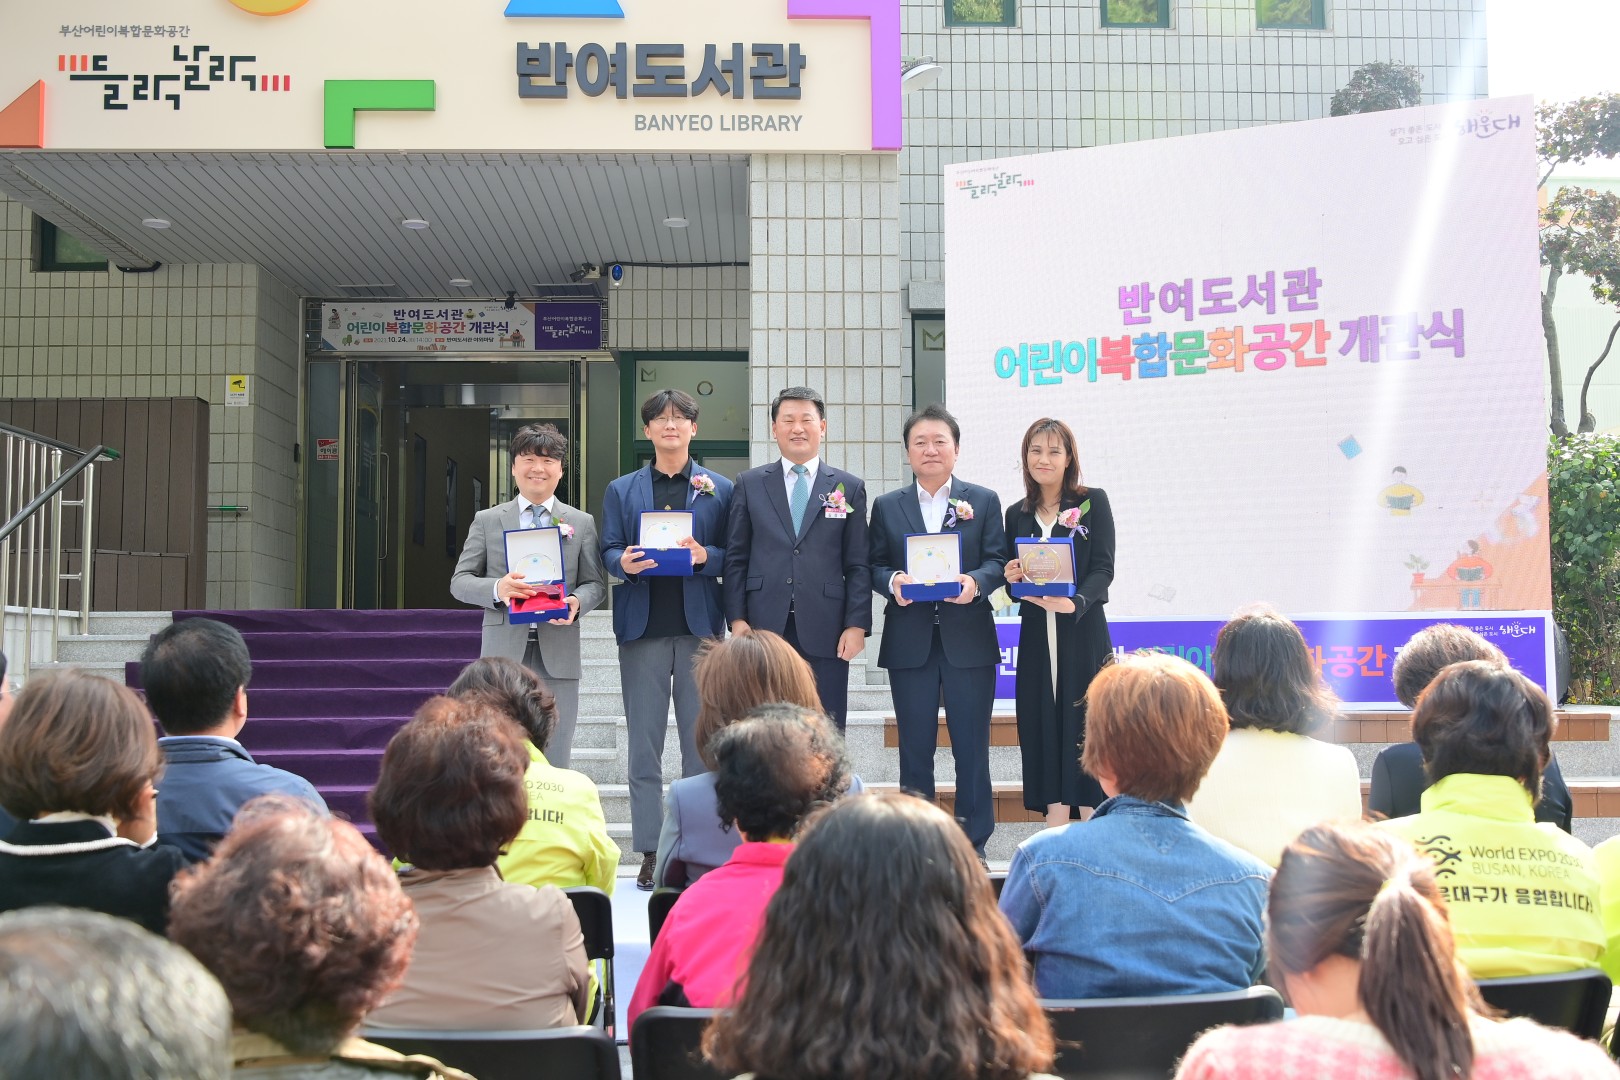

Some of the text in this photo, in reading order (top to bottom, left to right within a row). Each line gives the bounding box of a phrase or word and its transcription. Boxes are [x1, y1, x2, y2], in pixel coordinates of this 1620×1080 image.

[58, 24, 191, 38] 부산어린이복합문화공간
[516, 41, 807, 100] 반여도서관
[634, 114, 803, 132] BANYEO LIBRARY
[1118, 266, 1323, 326] 반여도서관
[393, 309, 465, 321] 반여도서관
[346, 321, 510, 335] 어린이복합문화공간 개관식
[994, 308, 1466, 388] 어린이복합문화공간 개관식
[1498, 621, 1536, 637] 해운대
[536, 781, 564, 792] 2030
[1469, 845, 1515, 860] World
[1519, 847, 1557, 864] EXPO
[1472, 861, 1571, 880] BUSAN, KOREA
[1439, 885, 1594, 913] 운대구가 응원합니다!
